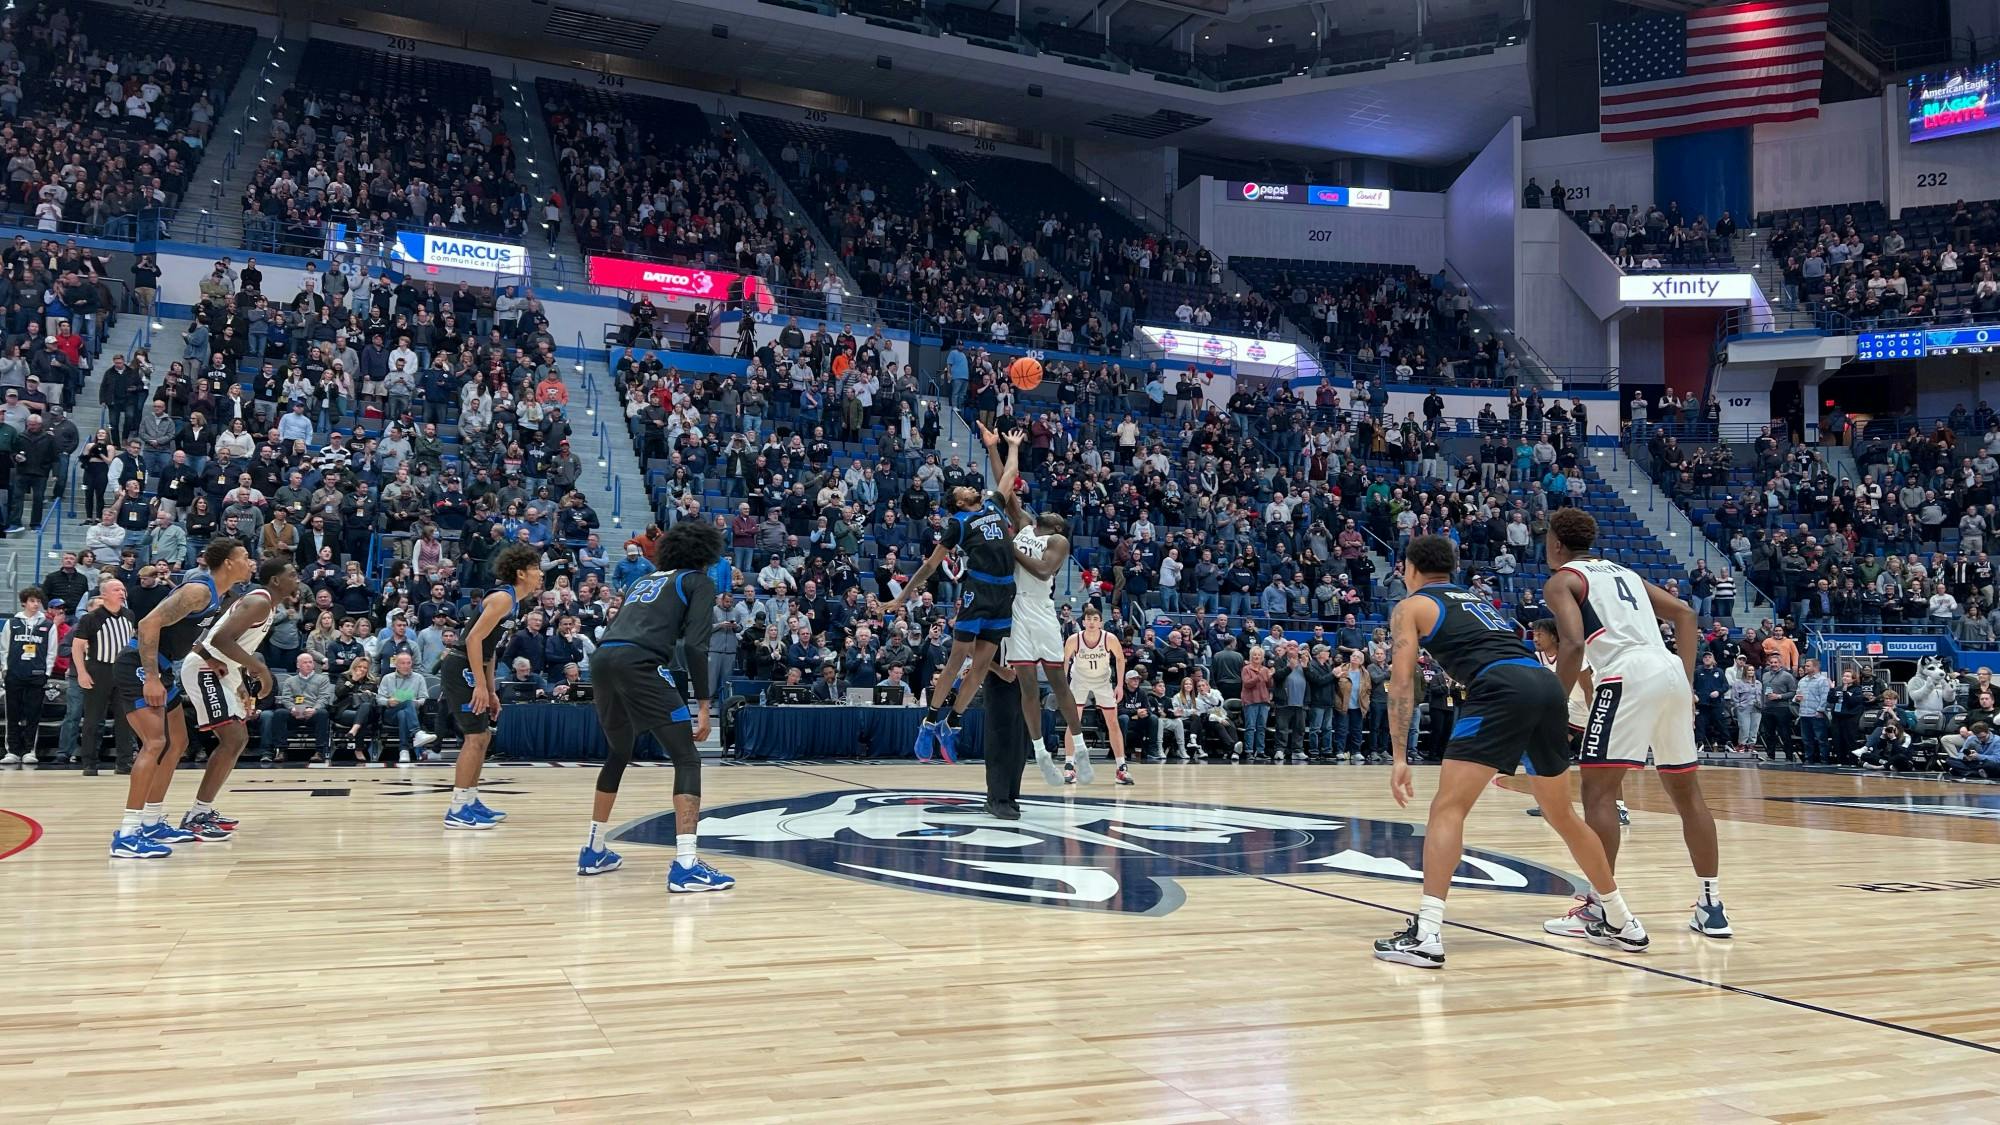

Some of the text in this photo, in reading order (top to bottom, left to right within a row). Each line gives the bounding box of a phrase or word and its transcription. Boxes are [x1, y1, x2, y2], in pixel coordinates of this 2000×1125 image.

[388, 37, 416, 51] 203
[598, 73, 624, 88] 204
[1922, 85, 1964, 99] American
[1964, 79, 1990, 91] Eagle
[804, 109, 827, 123] 205
[974, 137, 996, 151] 206
[1917, 172, 1948, 188] 232
[1260, 185, 1289, 196] pepsi
[1566, 186, 1590, 200] 231
[1308, 230, 1333, 242] 207
[431, 240, 511, 262] MARCUS
[643, 271, 690, 286] DATTCO
[1652, 277, 1720, 298] xfinity
[1876, 340, 1883, 348] 0
[1901, 339, 1908, 347] 0
[1913, 338, 1920, 346] 0
[1976, 330, 1989, 342] 0
[1025, 350, 1045, 360] 105
[1860, 348, 1921, 359] 23 0 0 0 0
[1728, 398, 1752, 407] 107
[980, 523, 1003, 541] 24
[623, 577, 669, 606] 23
[1614, 576, 1639, 611] 4
[1461, 601, 1515, 633] 13
[14, 635, 43, 644] UCONN
[1079, 652, 1107, 660] UCONN
[1088, 660, 1098, 670] 11
[202, 672, 222, 719] HUSKIES
[1586, 688, 1613, 757] HUSKIES
